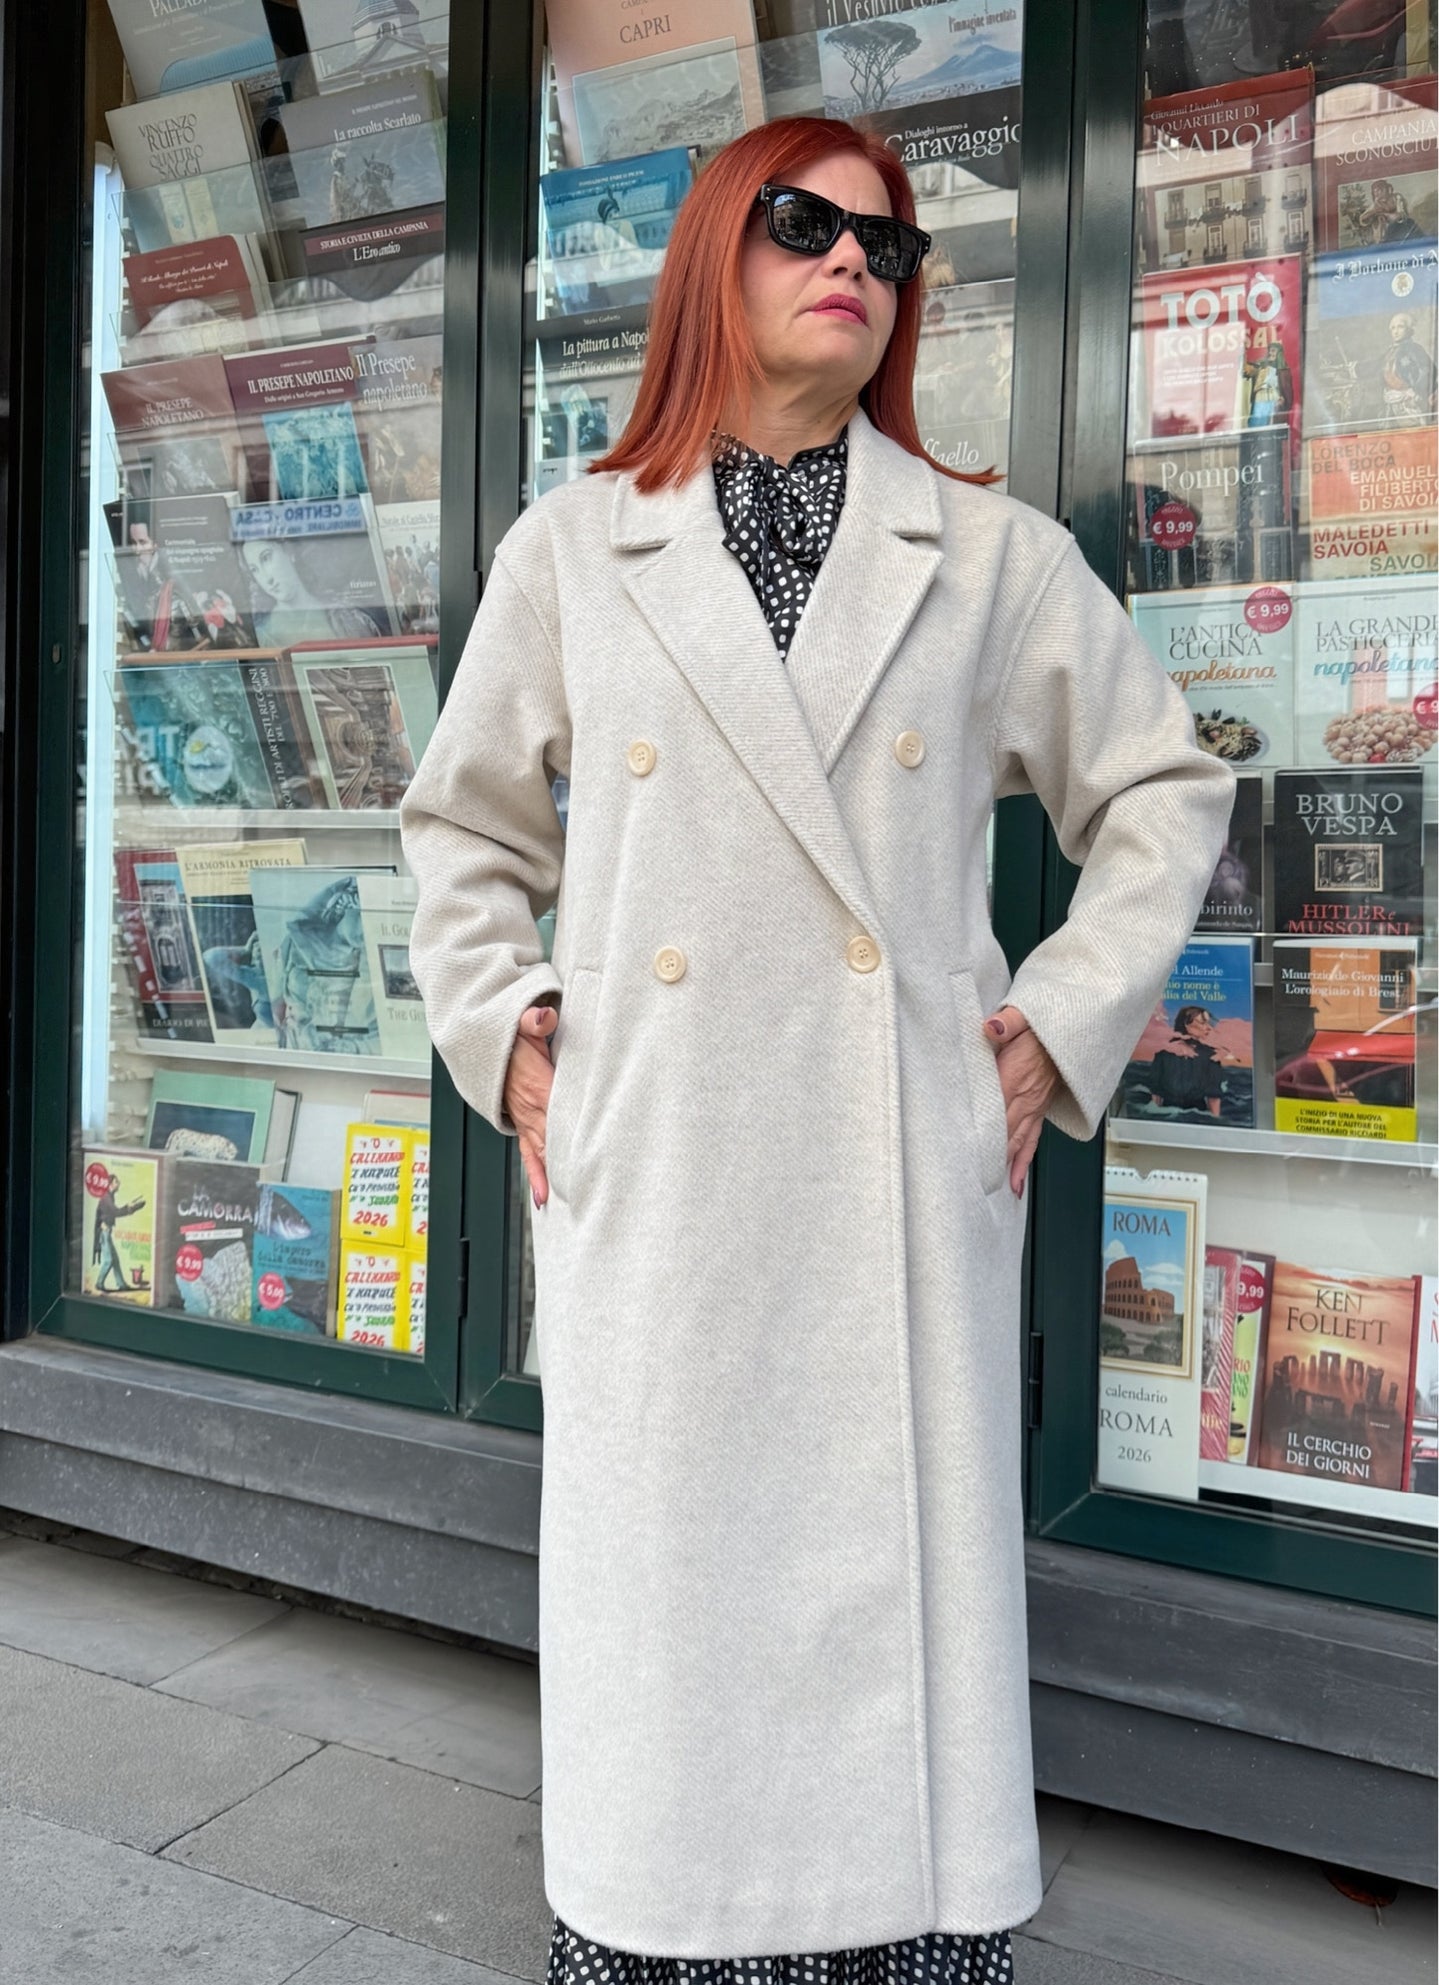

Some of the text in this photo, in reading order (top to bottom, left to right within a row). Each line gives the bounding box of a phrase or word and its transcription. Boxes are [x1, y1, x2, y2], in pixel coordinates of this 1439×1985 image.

[619, 14, 672, 43] CAPRI
[138, 113, 198, 138] VINCENZO
[333, 112, 422, 142] La raccolta Scarlato
[1160, 108, 1240, 135] QUARTIERI
[1243, 103, 1260, 118] DI
[146, 125, 196, 153] RUFFO
[904, 126, 935, 140] Dialoghi
[1153, 113, 1301, 167] NAPOLI
[1351, 119, 1437, 146] CAMPANIA
[149, 144, 204, 169] QUATTRO
[1335, 137, 1439, 167] SCONOSCIU
[371, 227, 394, 240] DELLA
[1160, 272, 1282, 331] TOTÒ
[562, 341, 574, 357] La
[576, 338, 610, 359] pittura
[611, 336, 619, 348] a
[355, 352, 417, 381] Il Presepe
[247, 365, 354, 395] IL PRESEPE NAPOLETANO
[362, 377, 428, 413] napoletano
[1312, 440, 1392, 460] LORENZO
[1312, 454, 1397, 475] DEL BOCA
[1159, 460, 1265, 498] Pompei
[1360, 498, 1376, 512] DI
[1152, 520, 1194, 535] € 9,99
[1313, 520, 1430, 543] MALEDETTI
[1313, 540, 1390, 560] SAVOIA
[1246, 603, 1290, 619] € 9,99
[1316, 620, 1343, 638] LA
[1169, 637, 1263, 661] CUCINA
[1166, 660, 1278, 692] apoletana
[262, 717, 281, 760] ARTISTI
[1295, 792, 1404, 815] BRUNO
[1301, 815, 1398, 836] VESPA
[1302, 903, 1397, 921] HITLER e
[1287, 919, 1411, 936] MUSSOLINI
[1181, 965, 1225, 977] Allende
[1281, 968, 1405, 984] Maurizio de Giovanni
[1182, 989, 1228, 1002] del Valle
[1183, 981, 1211, 991] nome
[1285, 983, 1401, 999] L'orologiaio di Brest
[1295, 1115, 1387, 1132] STORIA PER L'AUTORE DEL
[1299, 1107, 1383, 1123] L'INIZIO DI UNA NUOVA
[1295, 1124, 1388, 1140] COMMISSARIO RICCIARDI
[177, 1199, 253, 1224] CAMORRA
[352, 1210, 390, 1228] 2026
[1112, 1209, 1172, 1238] ROMA
[1316, 1288, 1363, 1316] KEN
[1286, 1305, 1391, 1346] FOLLETT
[350, 1330, 385, 1348] 2026
[1105, 1384, 1168, 1404] calendario
[1099, 1407, 1174, 1438] ROMA
[1118, 1445, 1152, 1462] 2026
[1286, 1431, 1373, 1461] IL CERCHIO
[1285, 1448, 1371, 1480] DEI GIORNI
